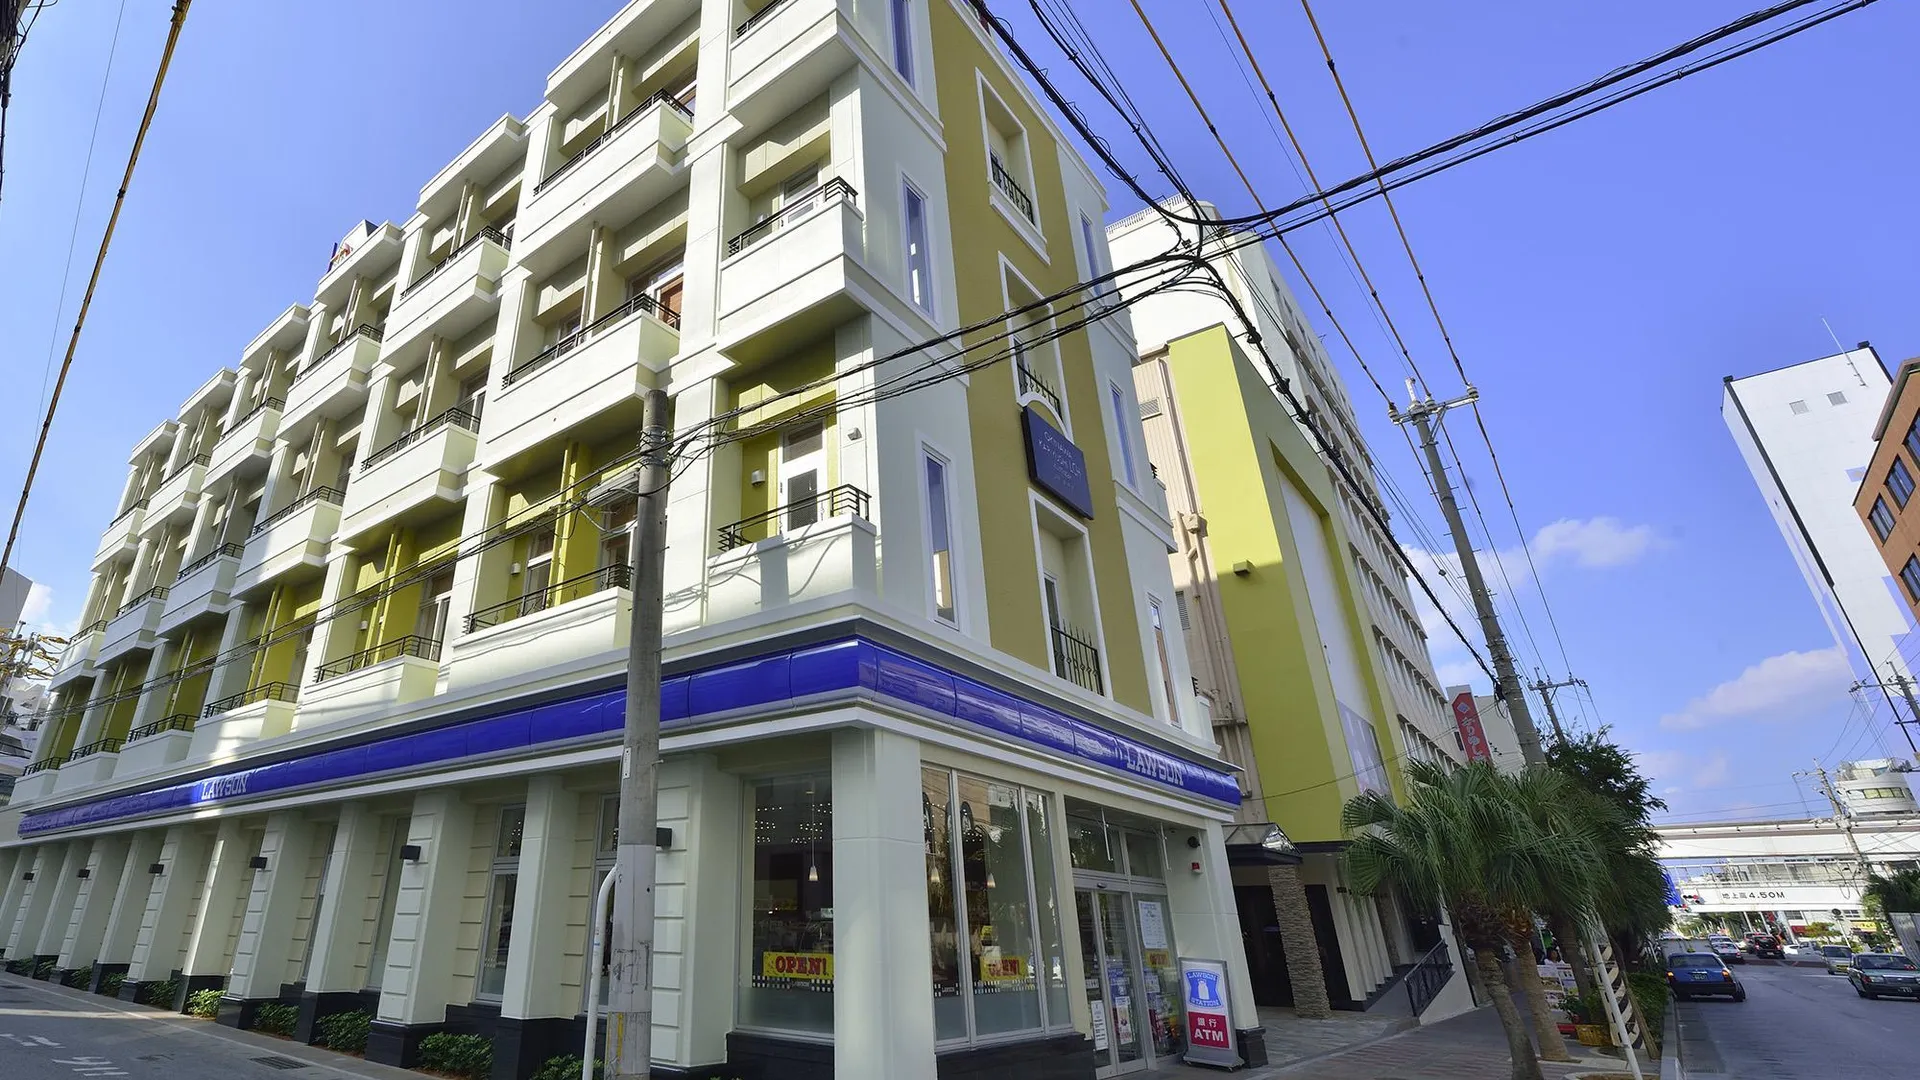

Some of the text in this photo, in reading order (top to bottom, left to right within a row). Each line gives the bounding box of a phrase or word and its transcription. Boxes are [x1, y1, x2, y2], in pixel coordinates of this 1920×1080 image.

[1126, 747, 1184, 786] LAWSON
[201, 774, 249, 800] LAWSON
[775, 955, 828, 976] OPEN!
[1188, 971, 1217, 981] LAWSON
[1190, 998, 1220, 1007] STATION
[1197, 1017, 1218, 1028] 銀行
[1194, 1029, 1224, 1042] ATM
